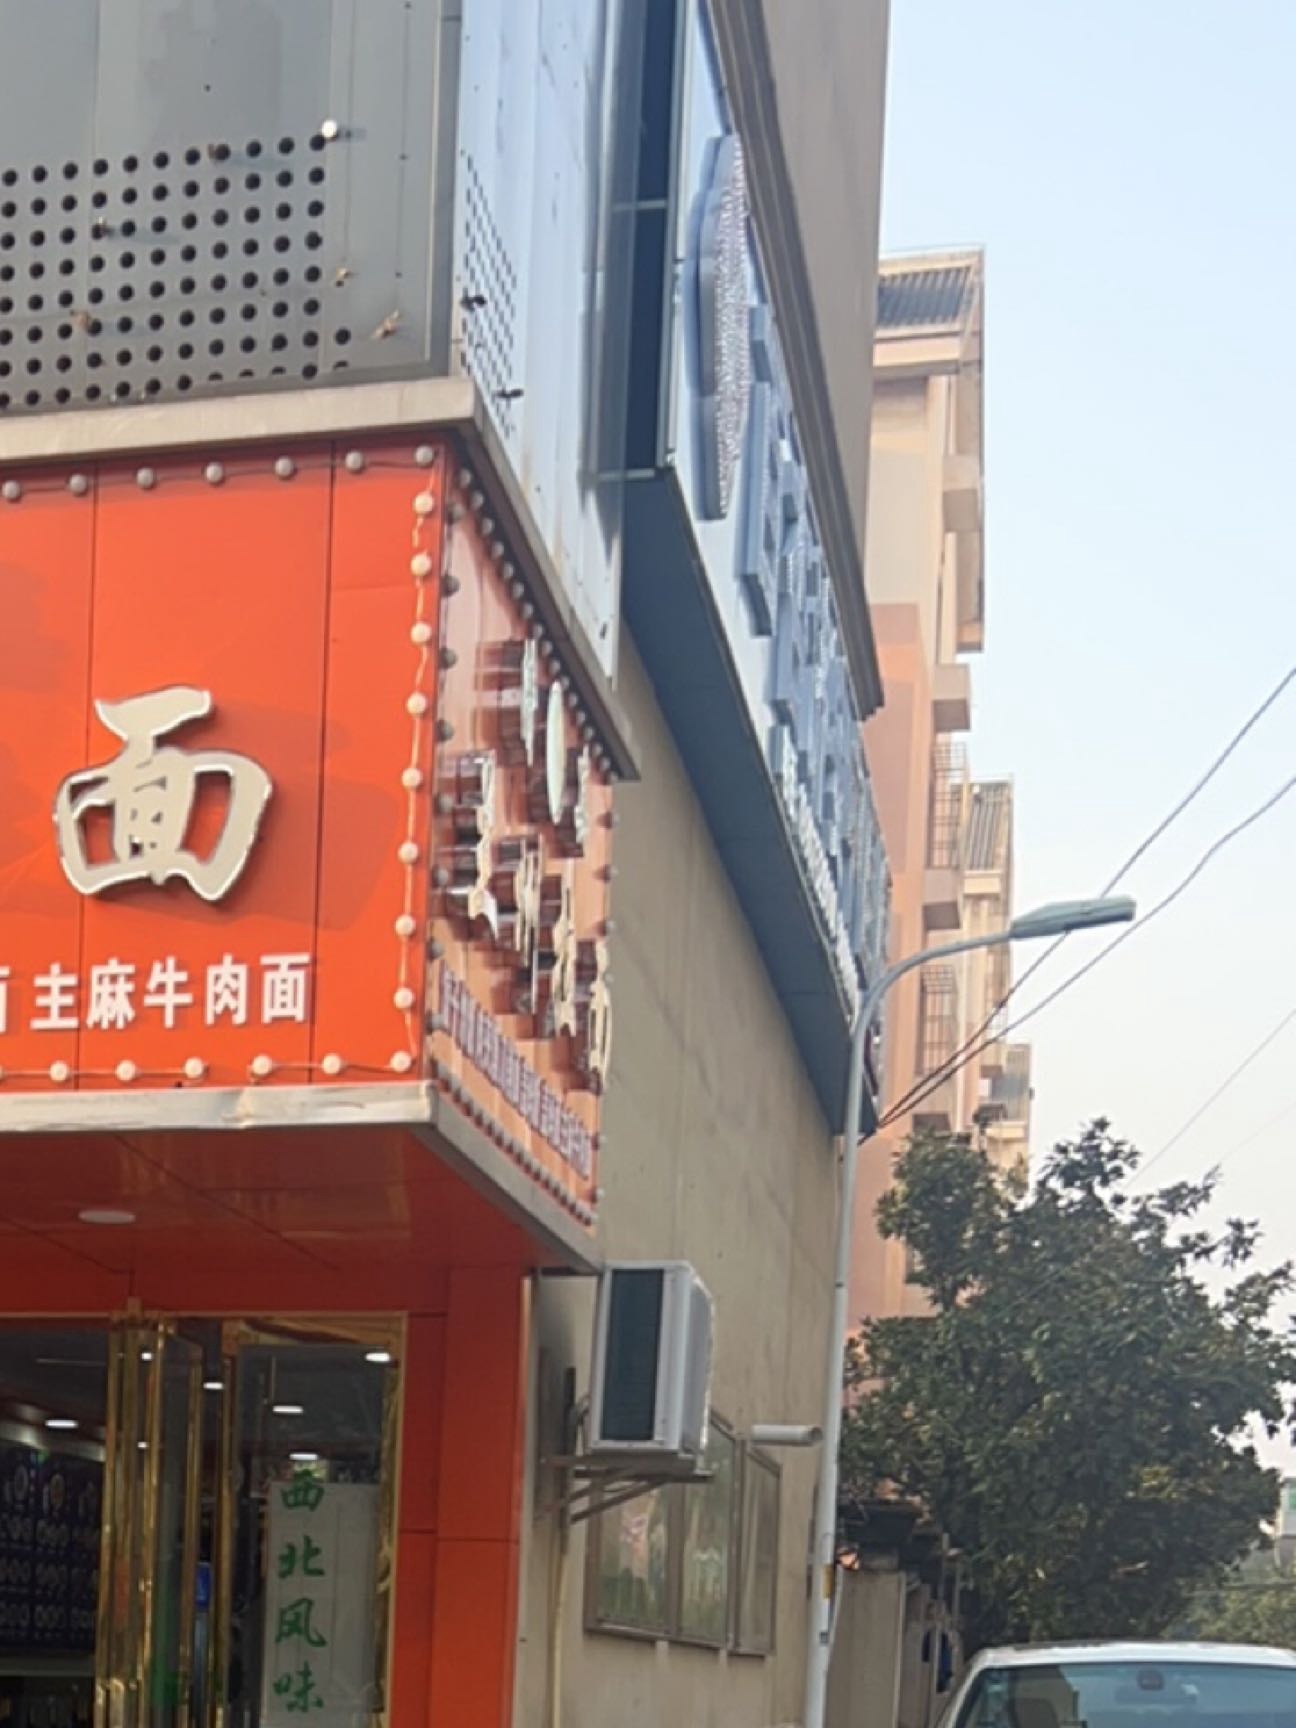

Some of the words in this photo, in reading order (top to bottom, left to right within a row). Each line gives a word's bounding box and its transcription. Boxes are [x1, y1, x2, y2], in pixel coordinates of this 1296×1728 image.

[30, 952, 311, 1031] 主麻牛肉面
[273, 1467, 328, 1714] 西北风味
